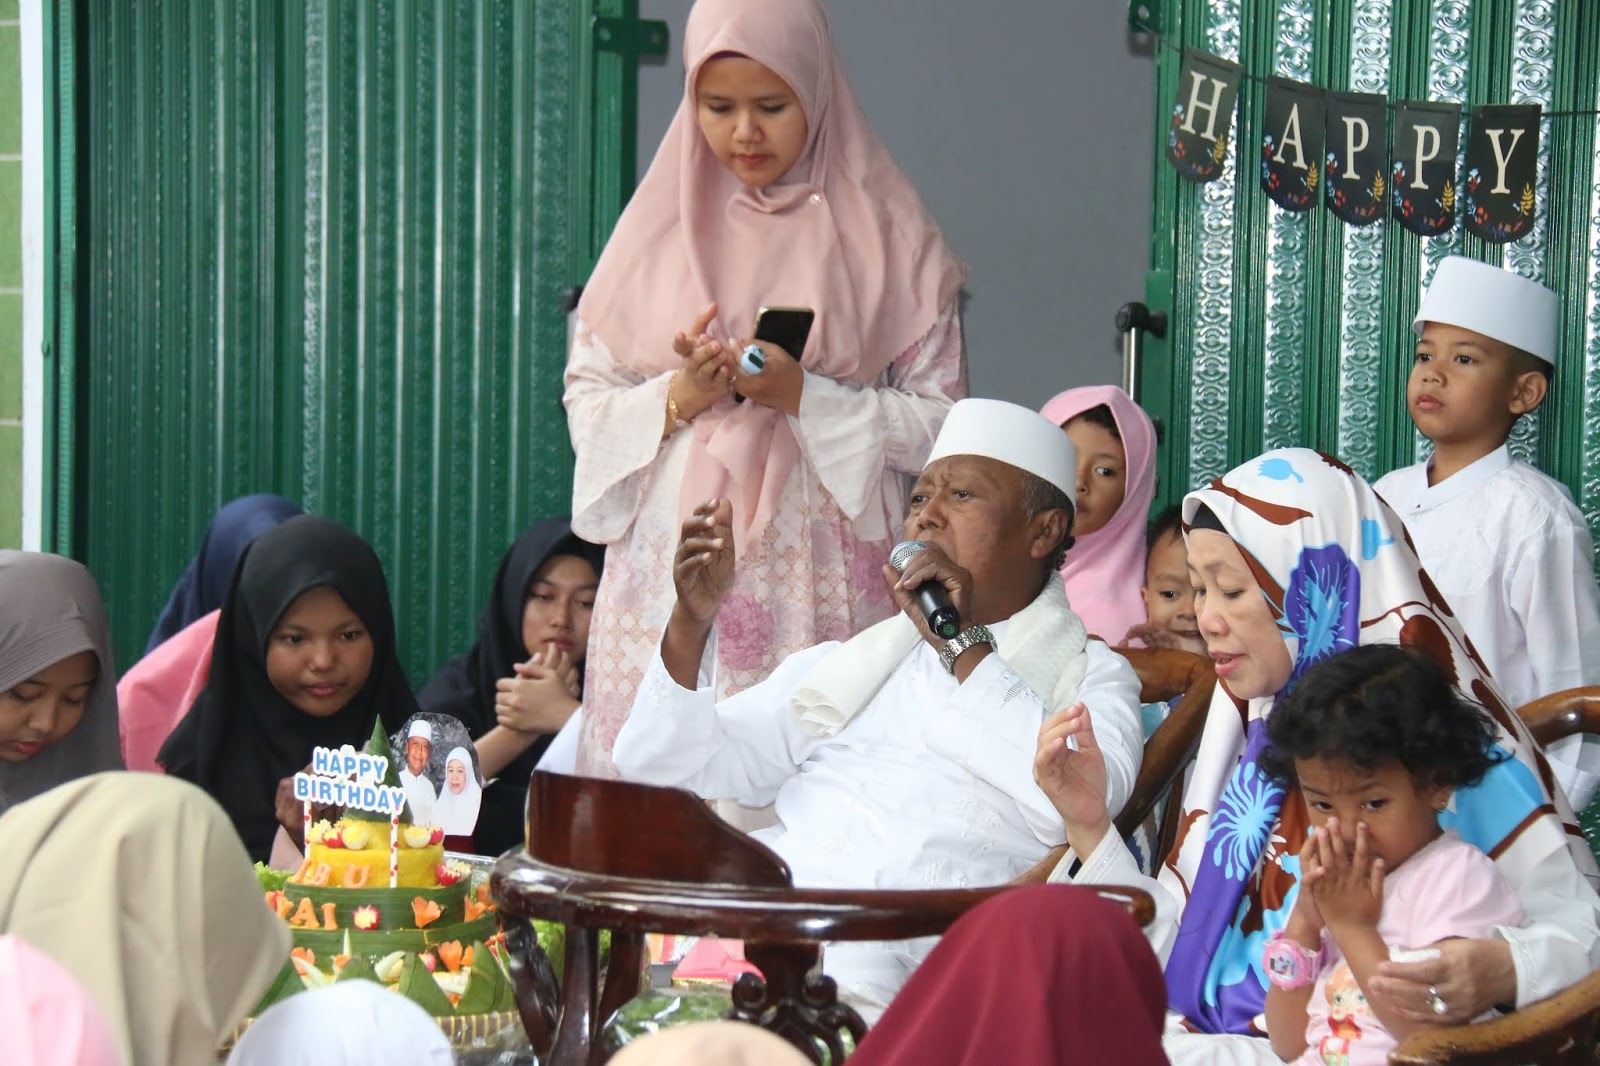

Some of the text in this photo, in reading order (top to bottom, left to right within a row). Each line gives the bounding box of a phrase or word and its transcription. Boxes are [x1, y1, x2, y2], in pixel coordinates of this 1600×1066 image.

[1180, 70, 1525, 194] HAPPY
[316, 751, 384, 780] HAPPY
[297, 777, 404, 811] BIRTHDAY
[287, 859, 371, 889] IBU
